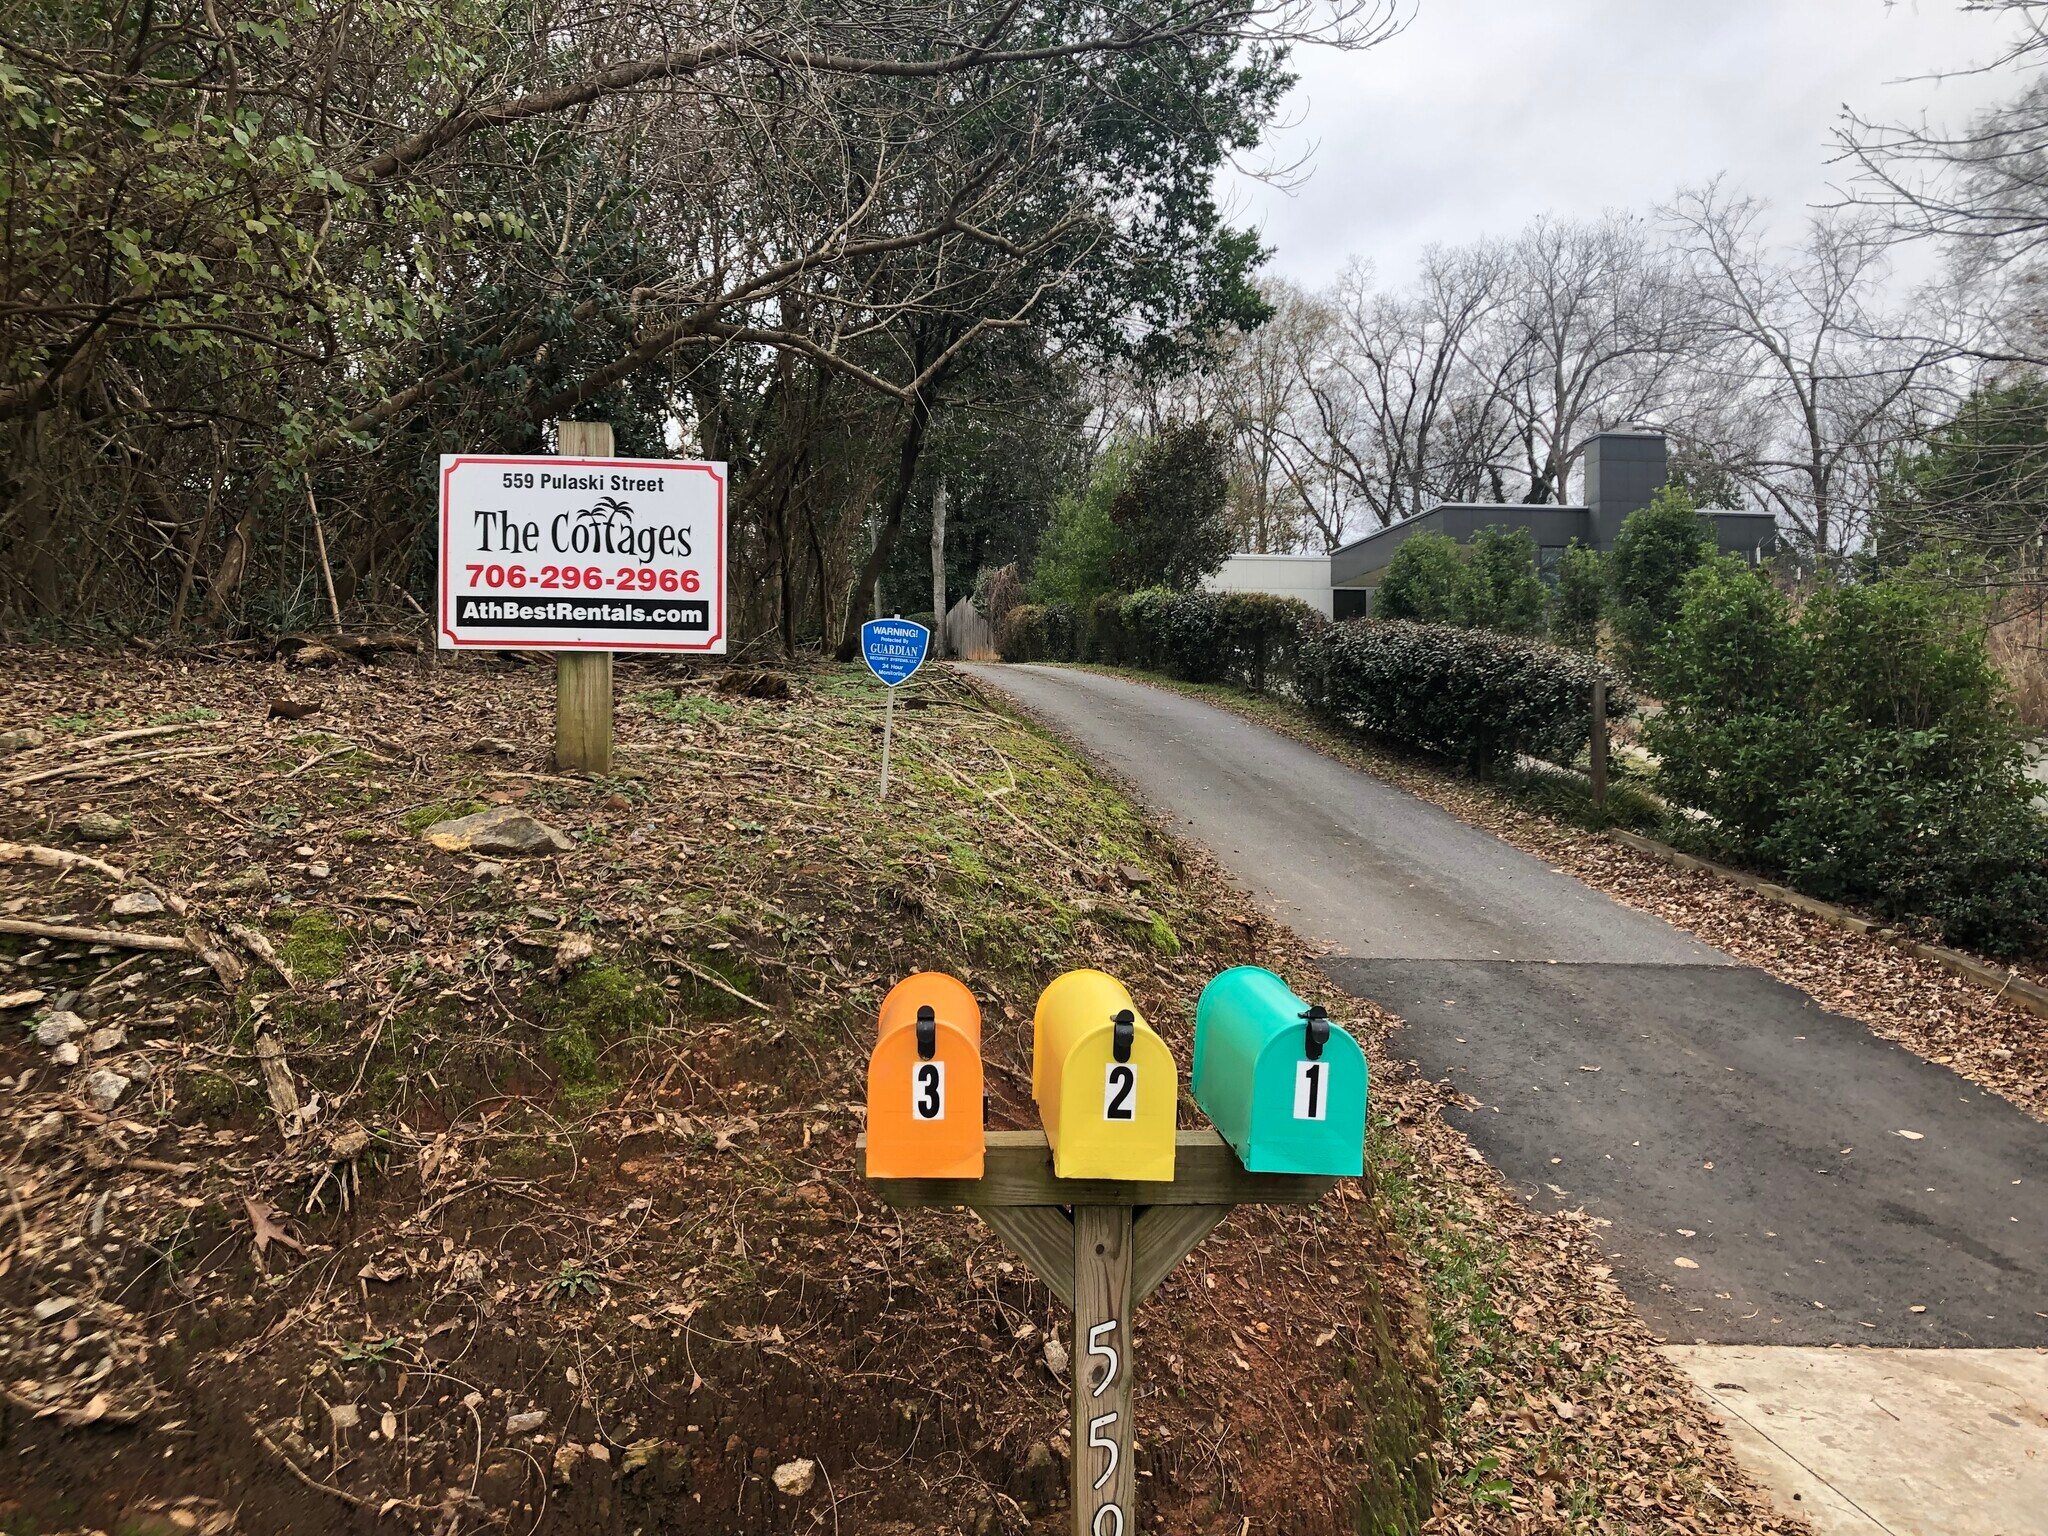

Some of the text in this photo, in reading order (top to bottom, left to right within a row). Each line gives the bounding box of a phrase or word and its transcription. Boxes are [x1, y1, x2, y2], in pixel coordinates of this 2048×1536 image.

[502, 473, 664, 492] 559 Pulaski Street
[474, 510, 692, 565] The Cottages
[465, 564, 700, 593] 706-296-2966
[462, 601, 702, 623] AthBestRentals.com
[873, 626, 918, 638] WARNING!
[870, 643, 918, 656] GUARDIAN
[917, 1064, 940, 1118] 3
[1106, 1065, 1134, 1119] 2
[1305, 1064, 1321, 1118] 1
